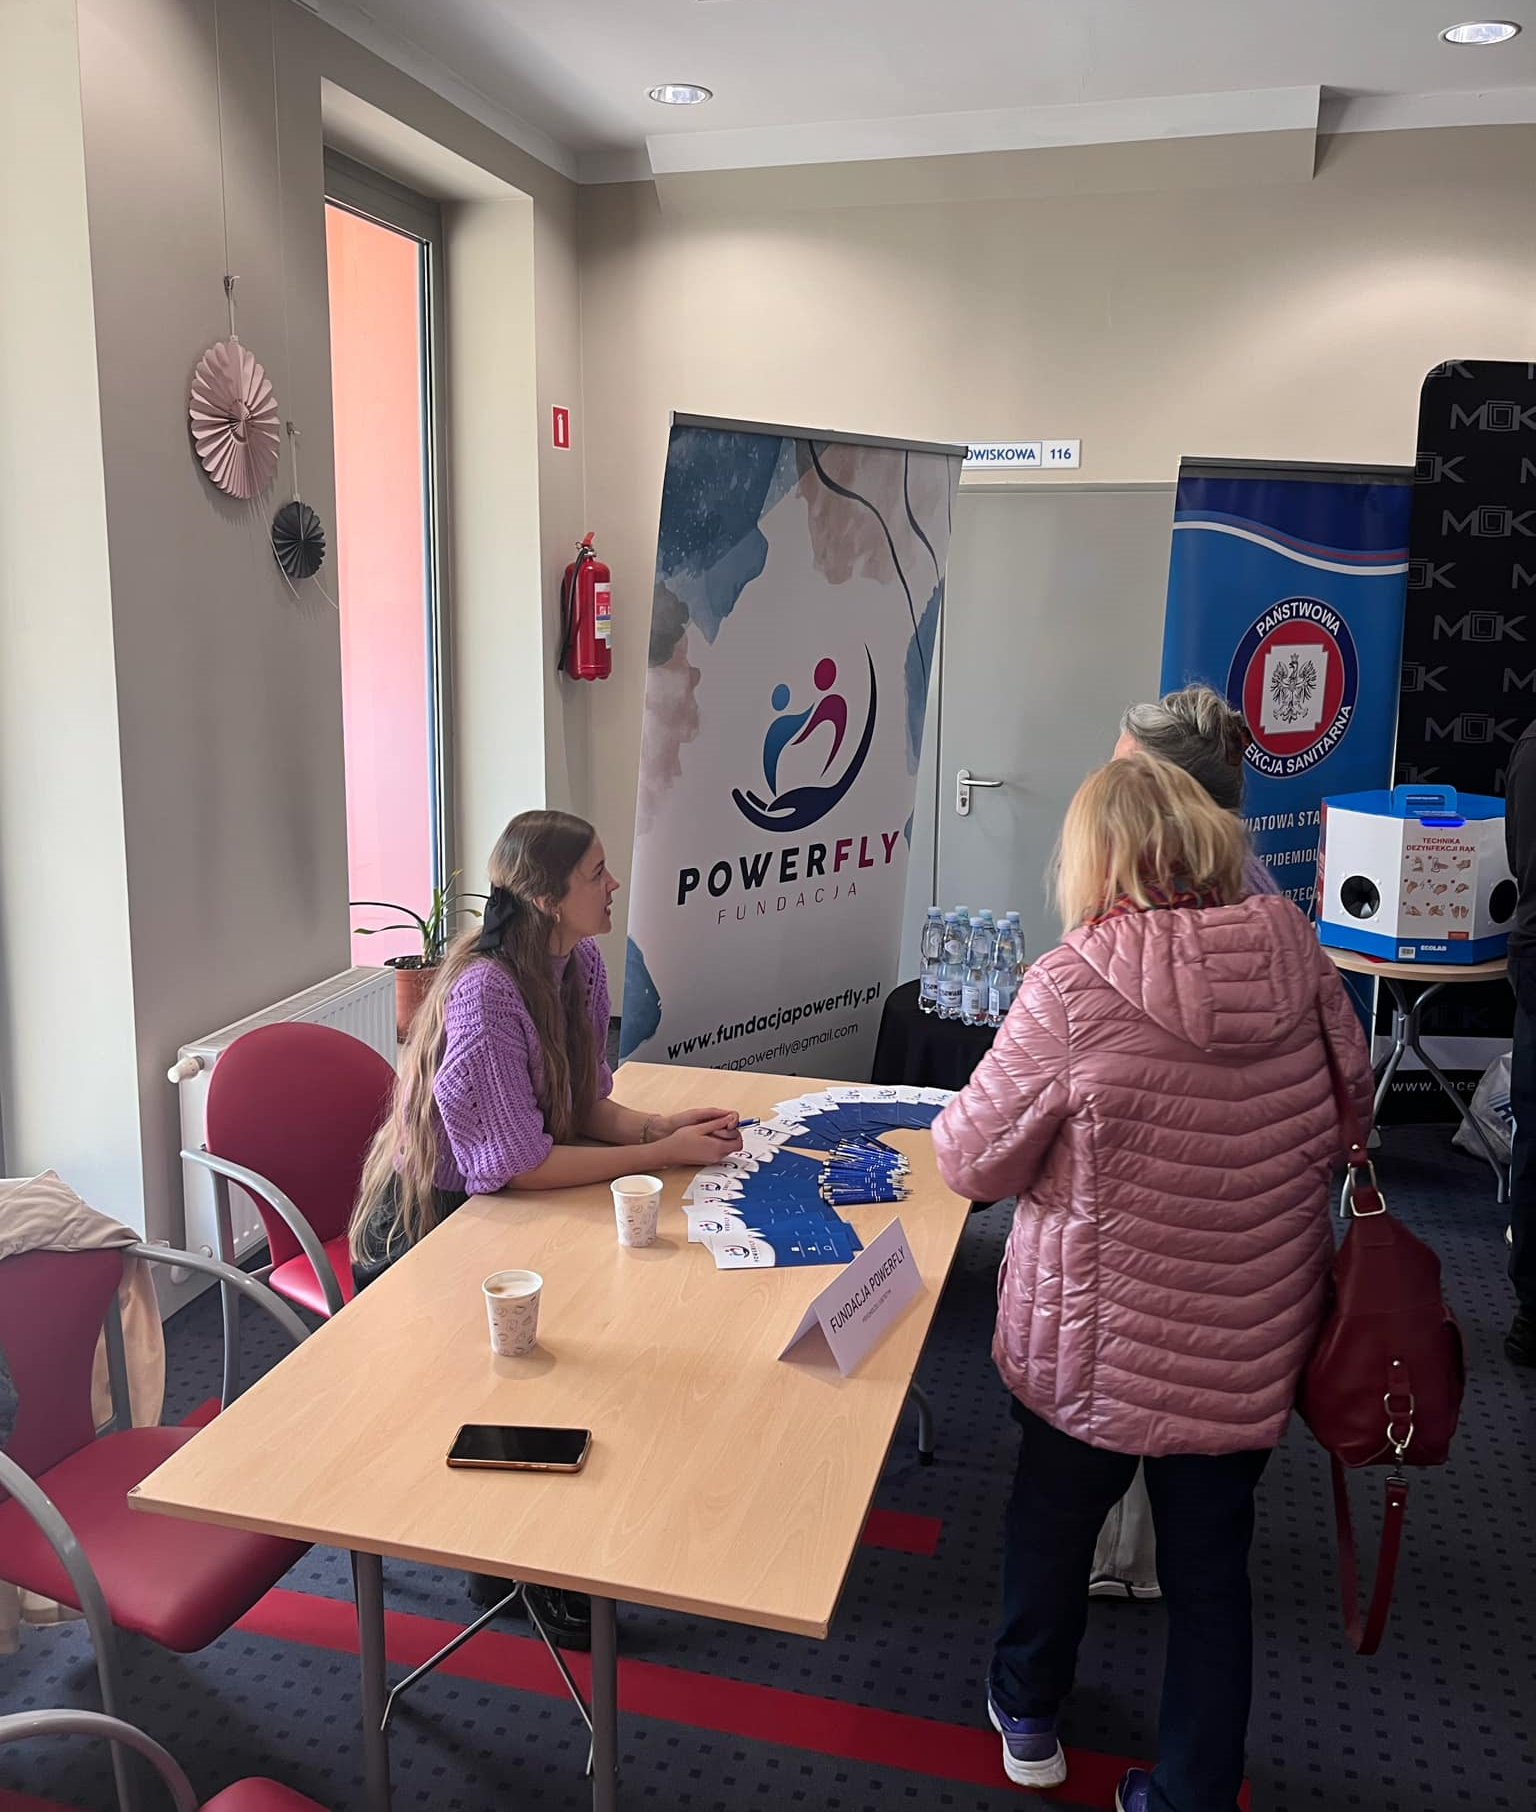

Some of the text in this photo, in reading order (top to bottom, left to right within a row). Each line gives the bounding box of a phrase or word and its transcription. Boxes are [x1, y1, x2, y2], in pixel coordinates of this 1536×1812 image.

[965, 448, 1072, 461] OWISKOWA 116
[1415, 452, 1466, 484] OK
[1408, 558, 1457, 590] OK
[1255, 601, 1341, 638] PAŃSTWOWA
[1432, 610, 1530, 642] MOK
[1243, 742, 1284, 774] EKCJA
[1286, 705, 1353, 773] SANITARNA
[1243, 810, 1321, 833] IATOWA STA
[1422, 837, 1461, 845] TECHNIKA
[676, 830, 900, 906] POWERFLY
[1259, 848, 1318, 868] EPIDEMIOL
[716, 881, 858, 925] FUNDACJA
[666, 981, 882, 1061] www.fundacjapowerfly.pl
[829, 1284, 871, 1334] FUNDACJA
[868, 1245, 906, 1293] POWERFLY
